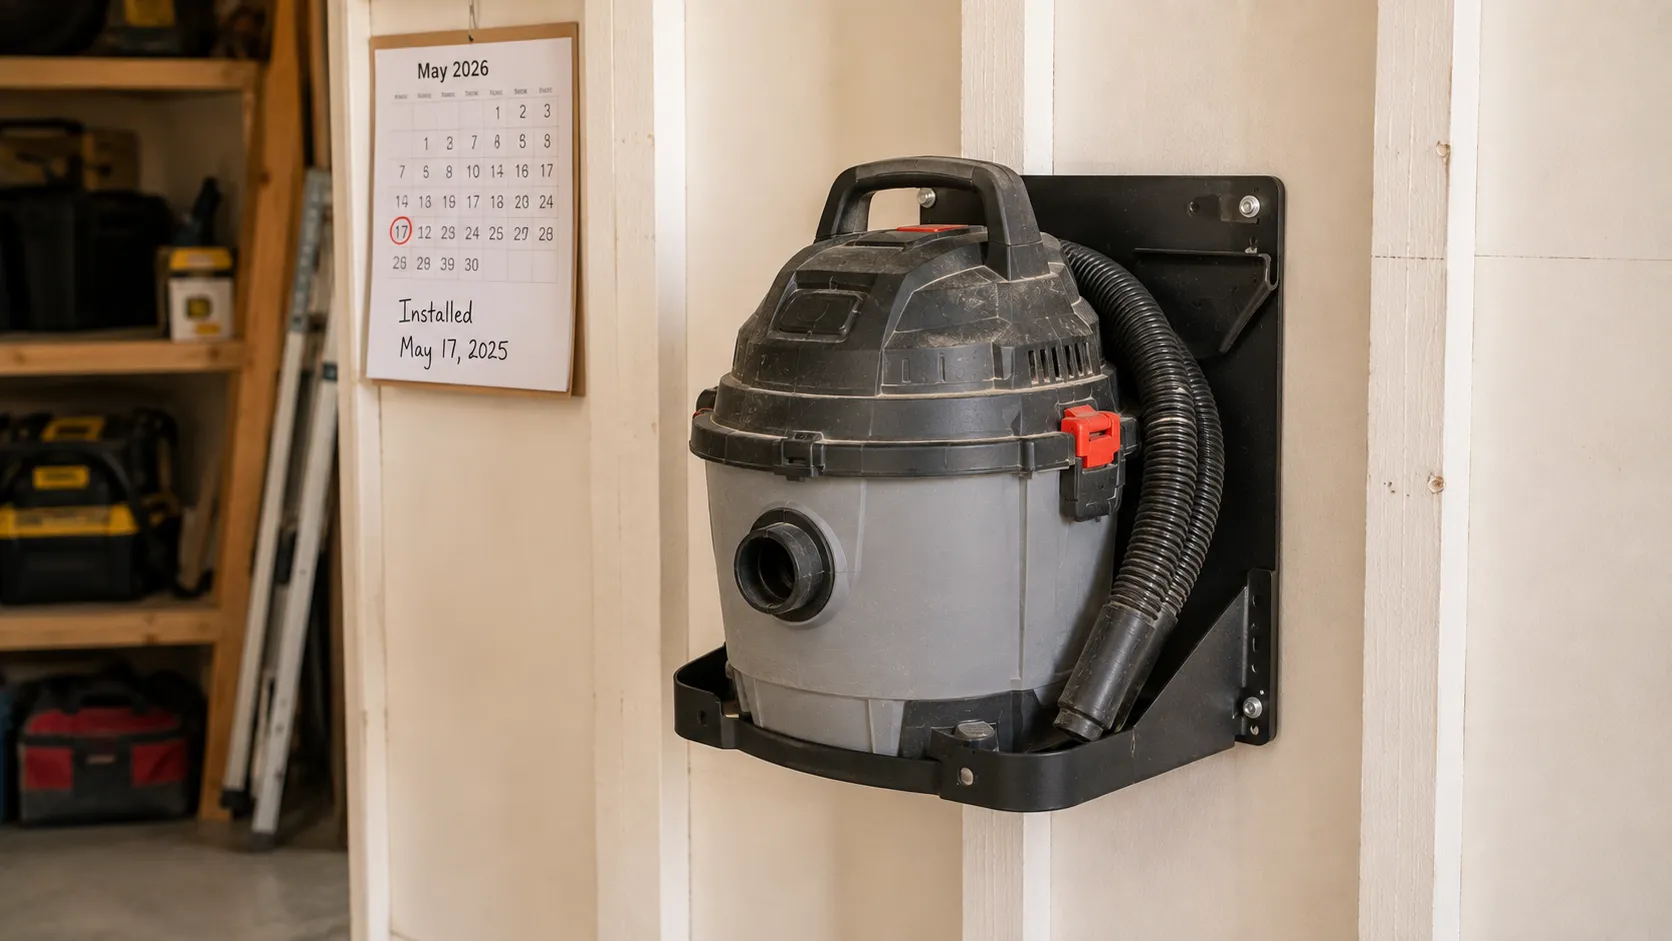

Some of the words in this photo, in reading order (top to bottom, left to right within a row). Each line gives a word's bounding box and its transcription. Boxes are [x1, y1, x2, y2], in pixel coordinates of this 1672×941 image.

[418, 63, 447, 83] May
[453, 60, 488, 77] 2026
[495, 105, 500, 120] 1
[519, 104, 527, 119] 2
[543, 103, 551, 119] 3
[424, 136, 429, 151] 1
[471, 134, 478, 150] 7
[399, 164, 406, 179] 7
[466, 163, 481, 179] 10
[540, 163, 554, 178] 17
[467, 194, 480, 209] 17
[539, 194, 554, 209] 24
[395, 225, 409, 239] 17
[418, 225, 432, 240] 12
[465, 226, 480, 241] 24
[464, 257, 479, 272] 30
[399, 299, 472, 323] Installed
[400, 336, 431, 370] May
[443, 339, 460, 364] 17,
[469, 339, 508, 360] 2025
